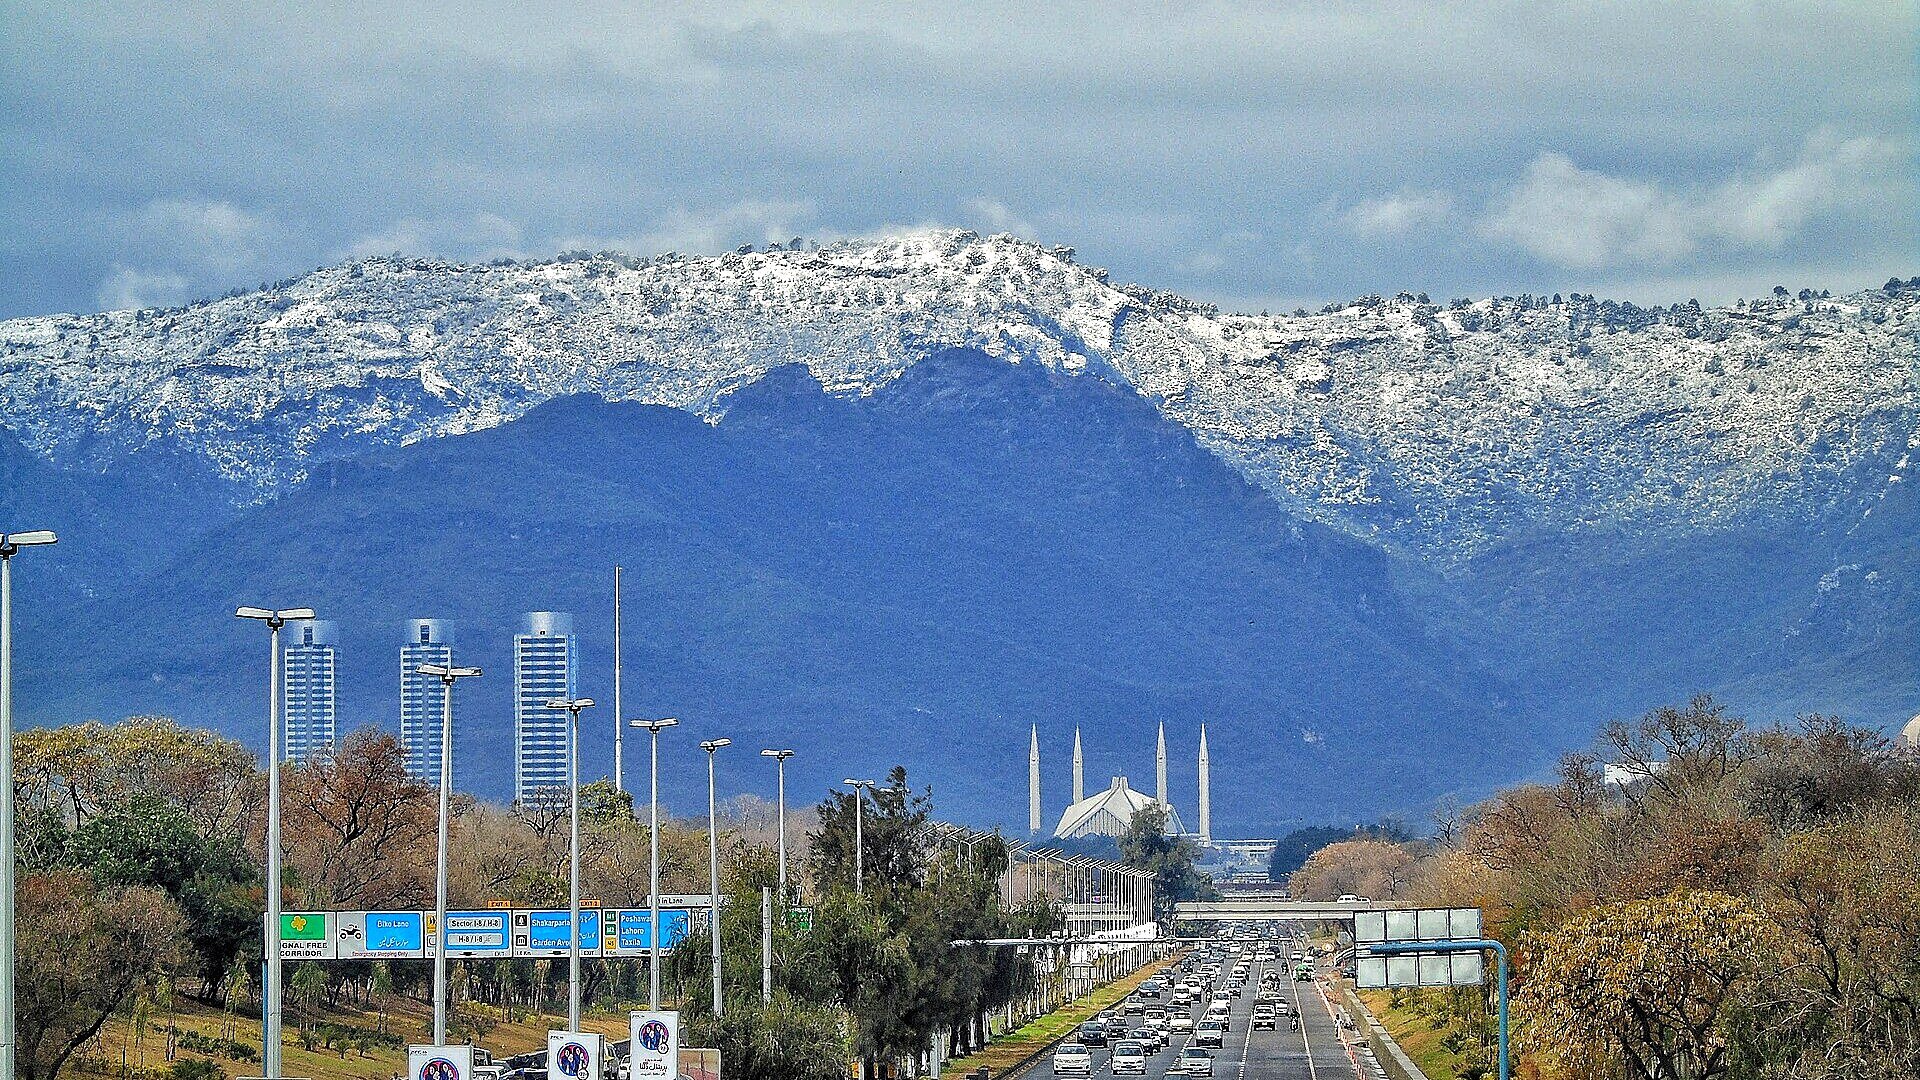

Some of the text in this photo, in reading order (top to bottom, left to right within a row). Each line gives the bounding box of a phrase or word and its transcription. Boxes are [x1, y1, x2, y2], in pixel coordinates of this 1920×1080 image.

[621, 914, 651, 923] Peshawa
[377, 919, 409, 928] Bike Lane
[451, 919, 472, 927] Sector
[532, 919, 571, 928] Shakarparia
[621, 927, 645, 935] Lahore
[532, 938, 556, 946] Garden
[622, 938, 641, 946] Taxila
